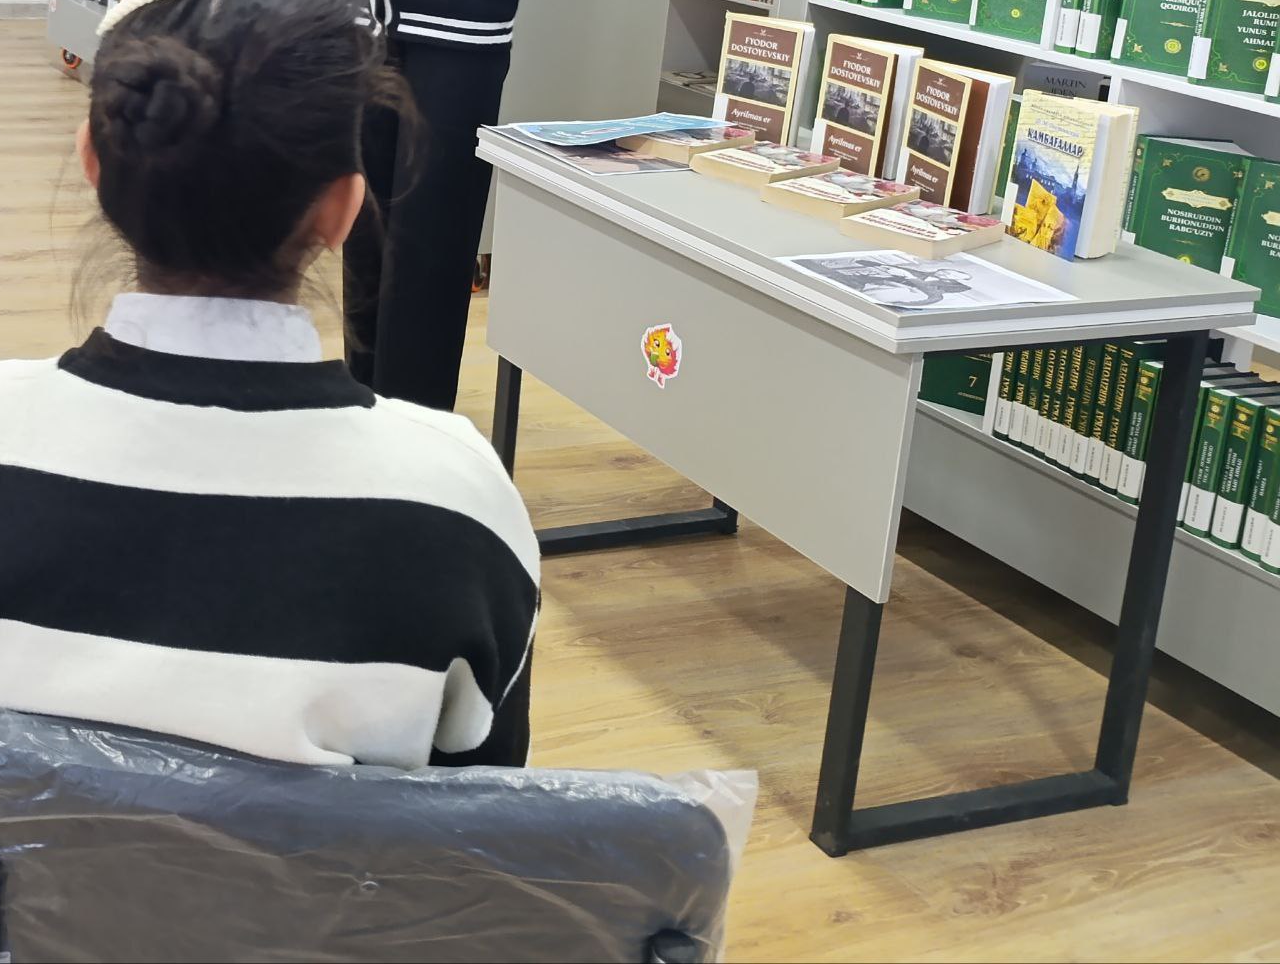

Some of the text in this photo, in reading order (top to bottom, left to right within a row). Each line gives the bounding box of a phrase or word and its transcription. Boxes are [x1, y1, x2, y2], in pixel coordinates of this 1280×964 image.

[1237, 26, 1267, 35] YUNUS
[744, 36, 778, 50] FYODOR
[730, 43, 790, 62] DOSTOYEVSKIY
[843, 59, 872, 75] FYODOR
[830, 66, 881, 88] DOSTOYEVSKIY
[1045, 76, 1086, 88] MARTIN
[926, 85, 950, 103] FYODOR
[916, 92, 959, 116] DOSTOYEVSKIY
[731, 108, 762, 123] Ayrilmas
[855, 145, 862, 153] er
[1161, 214, 1225, 232] BURHONUDDIN
[1166, 208, 1222, 224] NOSIRUDDIN
[1169, 223, 1214, 238] RABG'UZIY
[968, 376, 978, 387] 7
[1097, 353, 1113, 407] MIRZIYOYEV
[1114, 359, 1129, 413] MIRZIYOYEV
